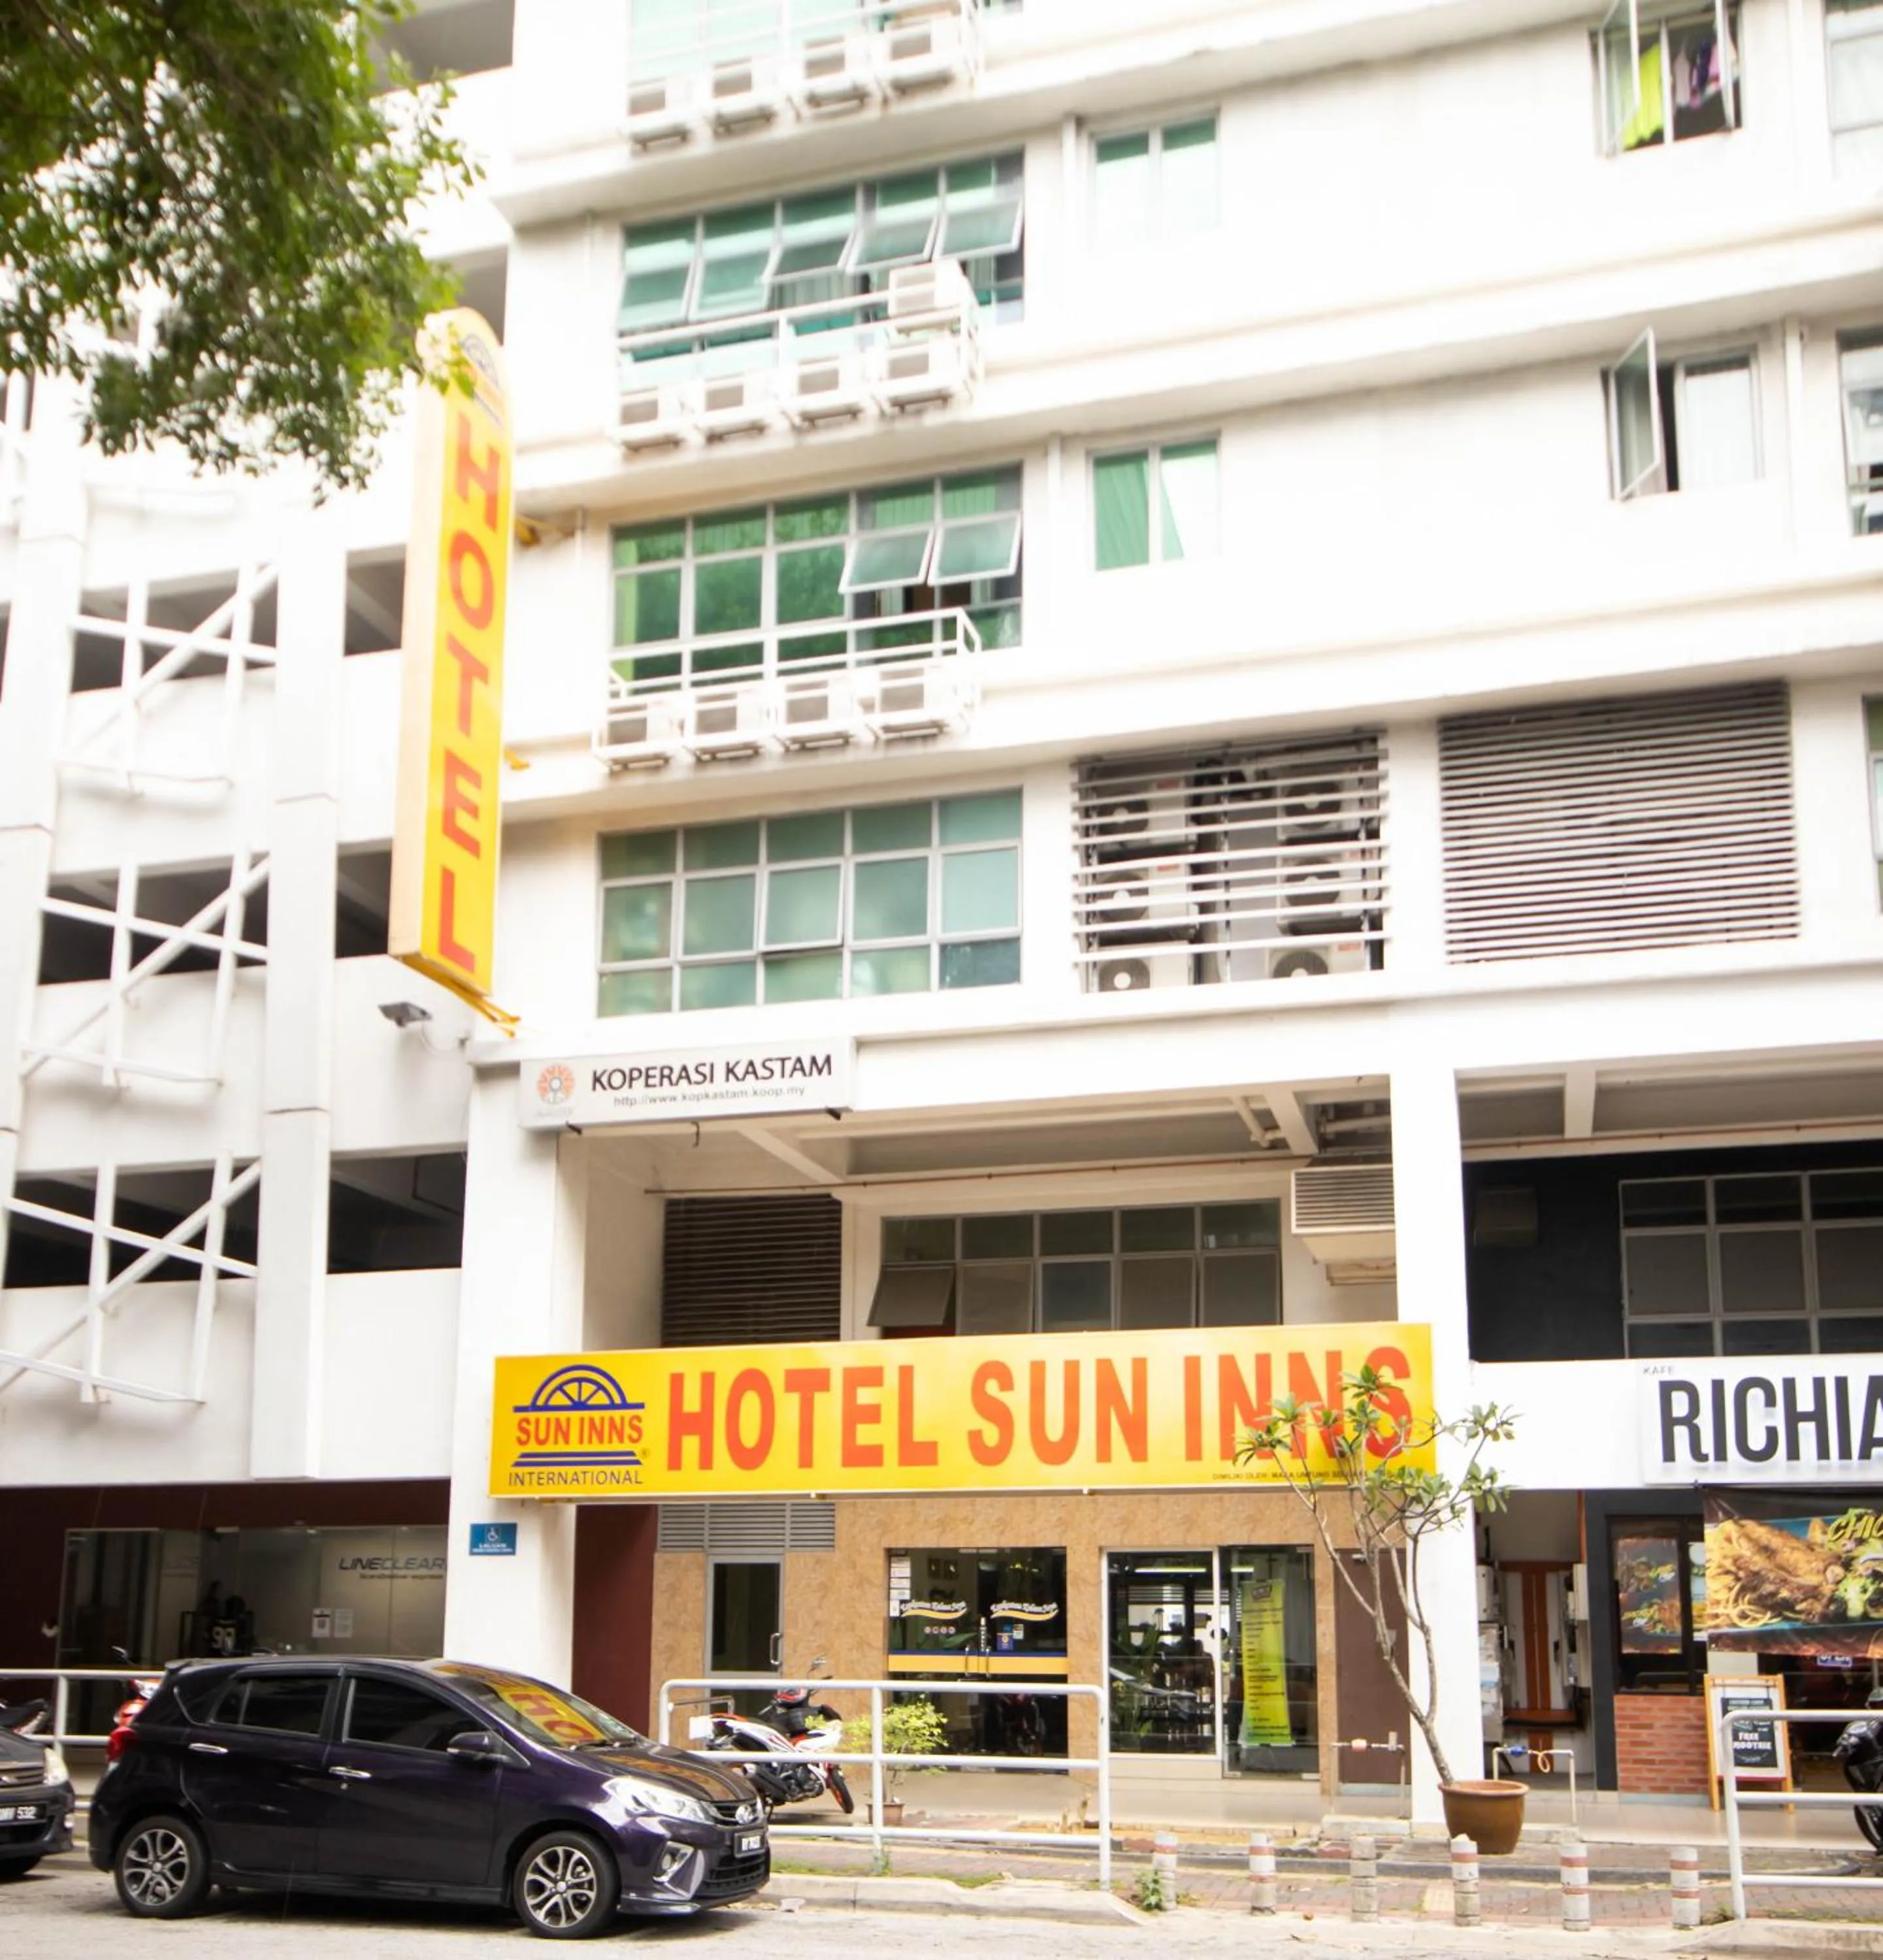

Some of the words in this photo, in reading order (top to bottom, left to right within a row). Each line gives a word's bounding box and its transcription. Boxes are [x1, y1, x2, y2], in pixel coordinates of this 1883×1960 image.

[438, 410, 500, 973] HOTEL
[591, 1062, 714, 1091] KOPERASI
[725, 1054, 832, 1083] KASTAM
[516, 1416, 570, 1446] SUN
[579, 1414, 643, 1445] INNS
[667, 1365, 938, 1471] HOTEL
[968, 1357, 1148, 1467] SUN
[1183, 1346, 1413, 1462] INNS
[1658, 1374, 1883, 1463] RICHIA
[508, 1469, 644, 1486] INTERNATIONAL
